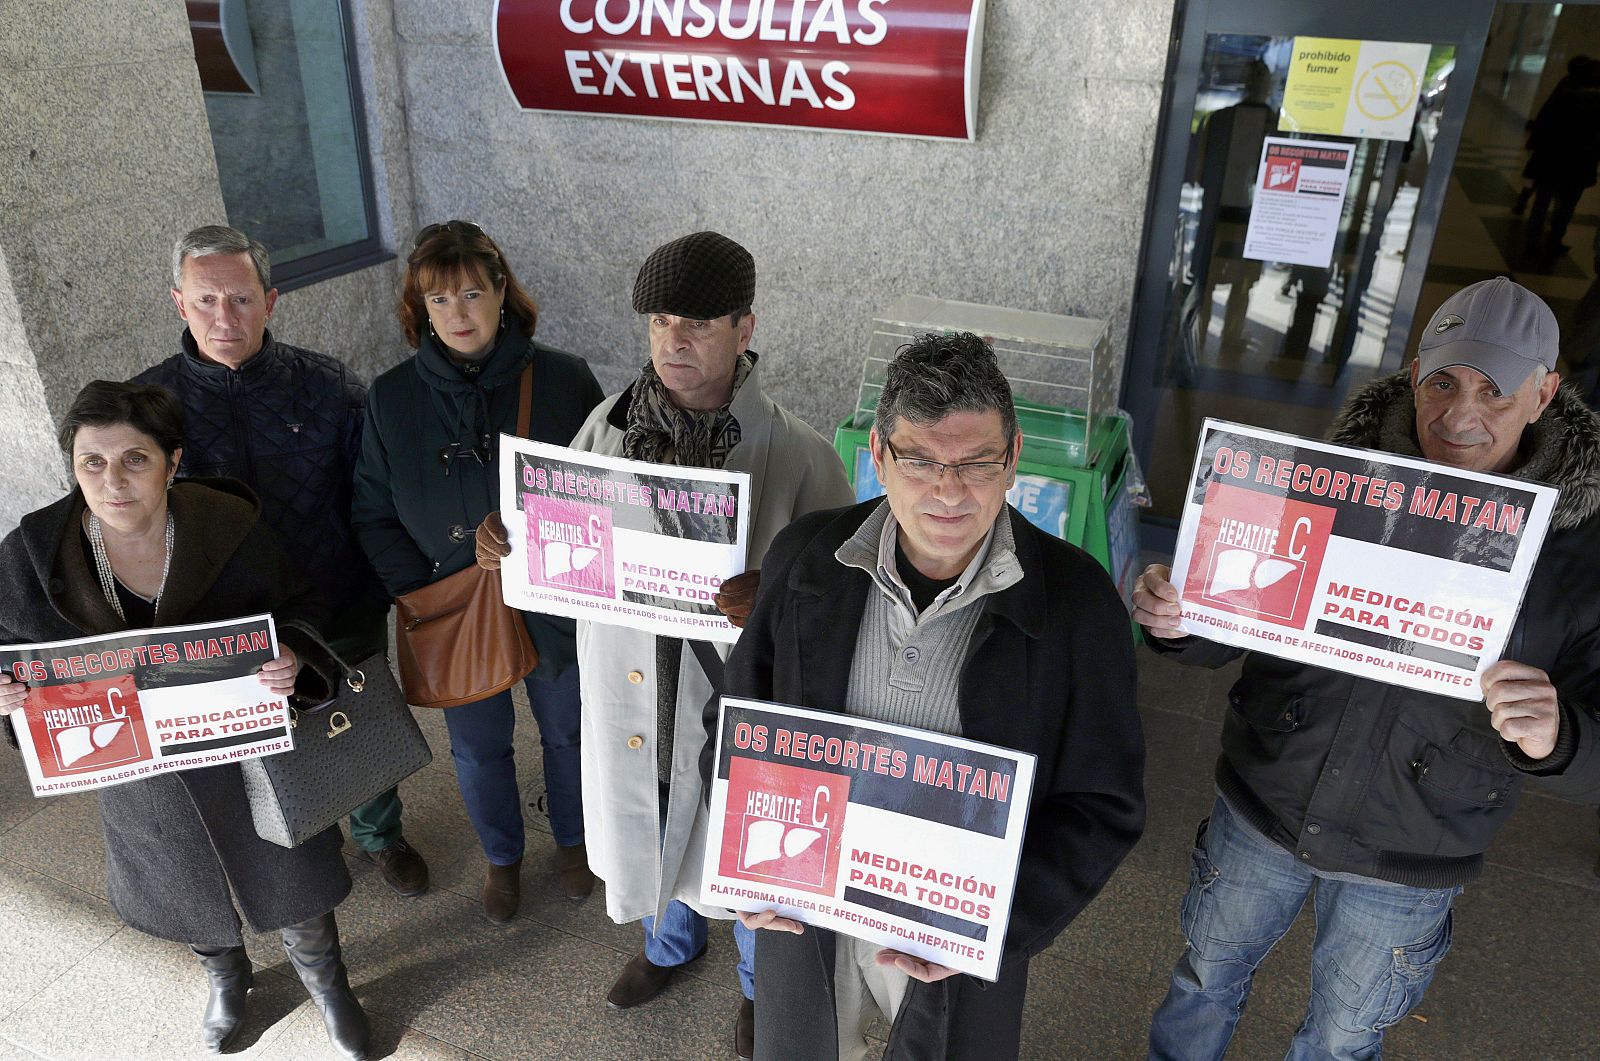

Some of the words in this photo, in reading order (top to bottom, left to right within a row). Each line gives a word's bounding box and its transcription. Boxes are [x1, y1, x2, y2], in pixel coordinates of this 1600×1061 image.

[559, 0, 891, 46] CONSULTAS
[1299, 50, 1351, 62] prohibido
[1306, 63, 1340, 75] fumar
[564, 49, 856, 111] EXTERNAS
[522, 466, 548, 489] OS
[552, 470, 653, 508] RECORTES
[657, 487, 735, 518] MATAN
[1213, 446, 1251, 479] OS
[1255, 455, 1404, 511] RECORTES
[1409, 486, 1525, 536] MATAN
[538, 519, 582, 544] HEPATITIS
[588, 514, 602, 547] C
[1219, 517, 1280, 554] HEPATITE
[1288, 516, 1312, 561] C
[623, 561, 724, 588] MEDICACIÓ
[624, 577, 670, 595] PARA
[571, 598, 600, 609] GALEGA
[613, 605, 656, 620] AFECTADOS
[658, 614, 678, 623] POLA
[680, 617, 728, 629] HEPATITIS
[1323, 602, 1391, 630] PARA
[1399, 619, 1485, 652] TODOS
[1327, 582, 1494, 632] MEDICACIÓN
[13, 660, 47, 682] OS
[53, 643, 180, 679] RECORTES
[183, 630, 269, 661] MATAN
[1180, 610, 1239, 632] LATAFORMA
[1241, 625, 1283, 644] GALEGA
[1284, 635, 1299, 647] DE
[1301, 640, 1364, 664] AFECTADOS
[1365, 655, 1395, 670] POLA
[1397, 661, 1462, 685] HEPATITE
[1462, 677, 1473, 687] C
[43, 704, 103, 729] HEPATITIS
[107, 687, 127, 719] C
[155, 700, 284, 730] MEDICACIÓN
[160, 727, 215, 743] PARA
[221, 714, 285, 735] TODOS
[36, 777, 99, 792] PLATAFORMA
[100, 769, 137, 783] GALEGA
[138, 766, 151, 774] DE
[152, 757, 203, 771] AFECTADOS
[205, 753, 228, 763] POLA
[229, 743, 282, 759] HEPATITIS
[734, 722, 768, 752] OS
[774, 728, 907, 778] RECORTES
[913, 755, 1011, 802] MATAN
[747, 790, 802, 824] HEPATITE
[812, 785, 830, 828] C
[849, 869, 908, 897] PARA
[915, 887, 991, 919] TODOS
[851, 848, 996, 899] MEDICACIÓN
[710, 884, 775, 903] PLATAFORMA
[777, 895, 816, 911] GALEGA
[818, 904, 832, 914] DE
[833, 909, 888, 933] AFECTADOS
[890, 926, 915, 941] POLA
[917, 932, 974, 959] HEPATITE
[976, 950, 985, 961] C
